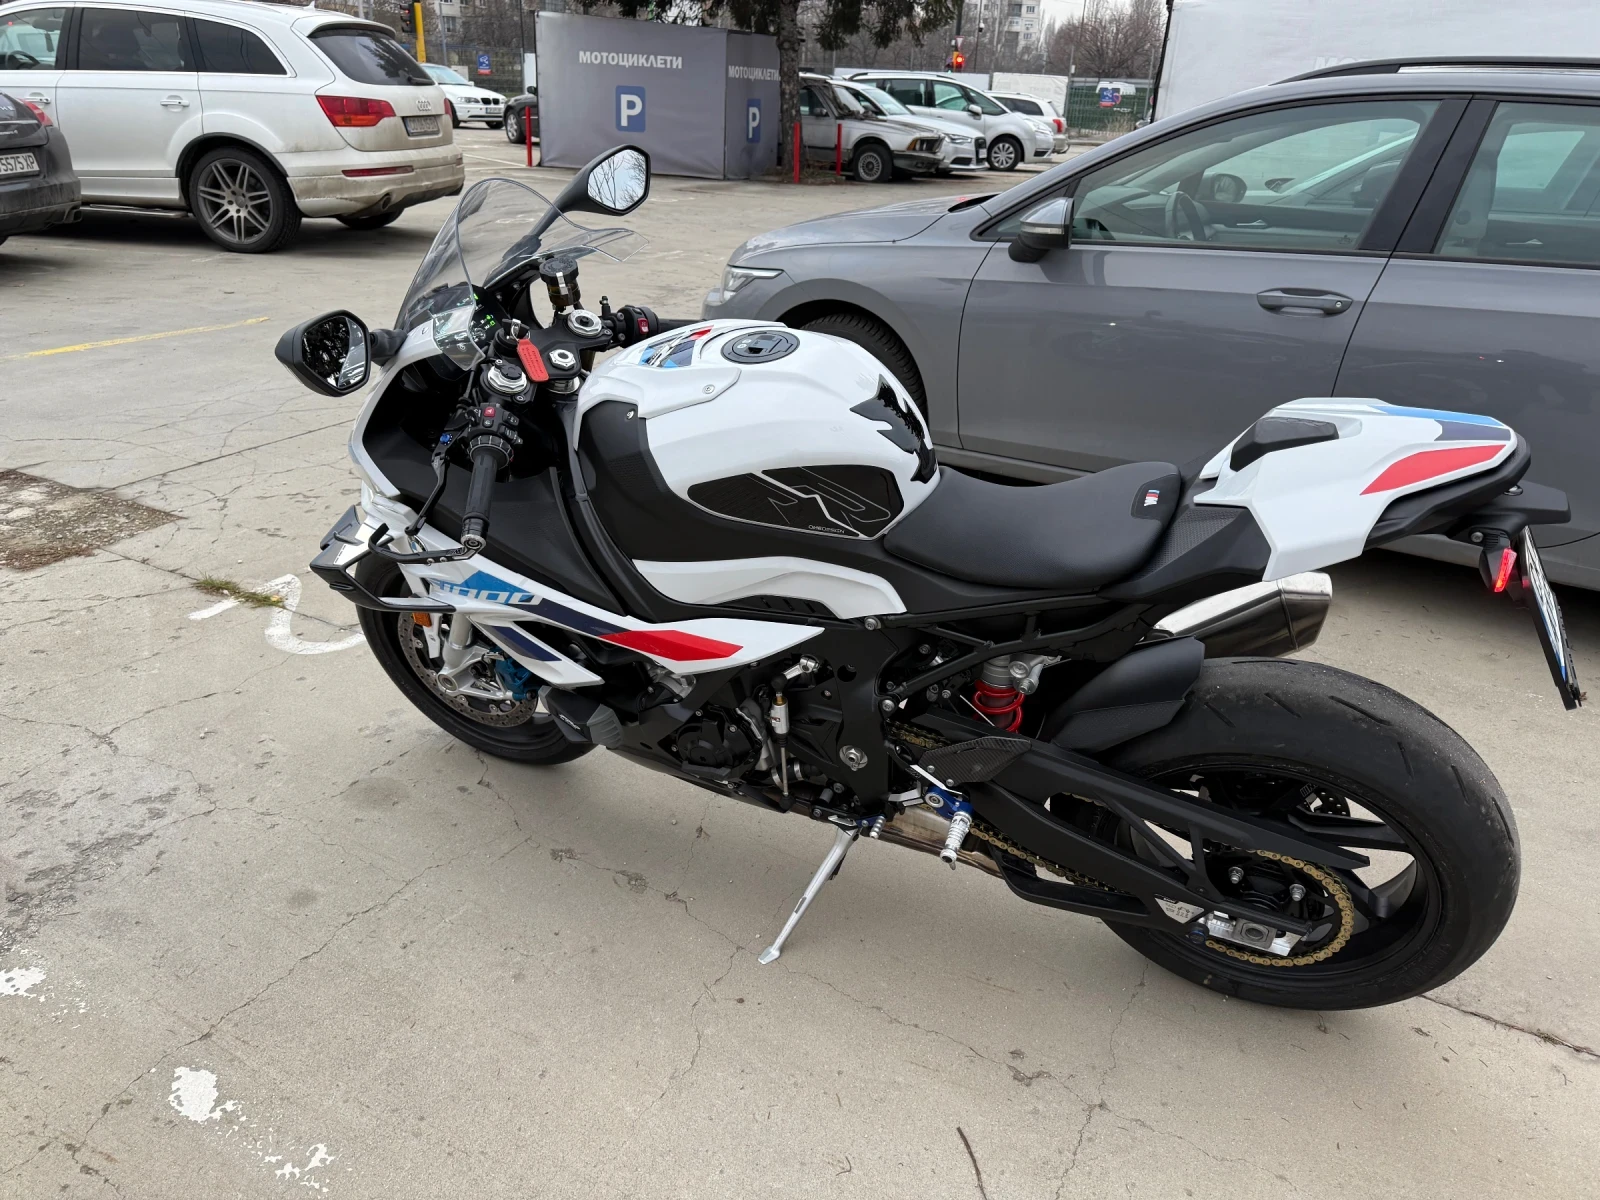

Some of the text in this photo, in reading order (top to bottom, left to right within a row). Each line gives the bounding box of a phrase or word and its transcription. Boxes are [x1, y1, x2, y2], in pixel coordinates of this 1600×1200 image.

[578, 50, 683, 69] МОТОЦИКЛЕТИ
[620, 93, 643, 127] P
[748, 106, 760, 139] P
